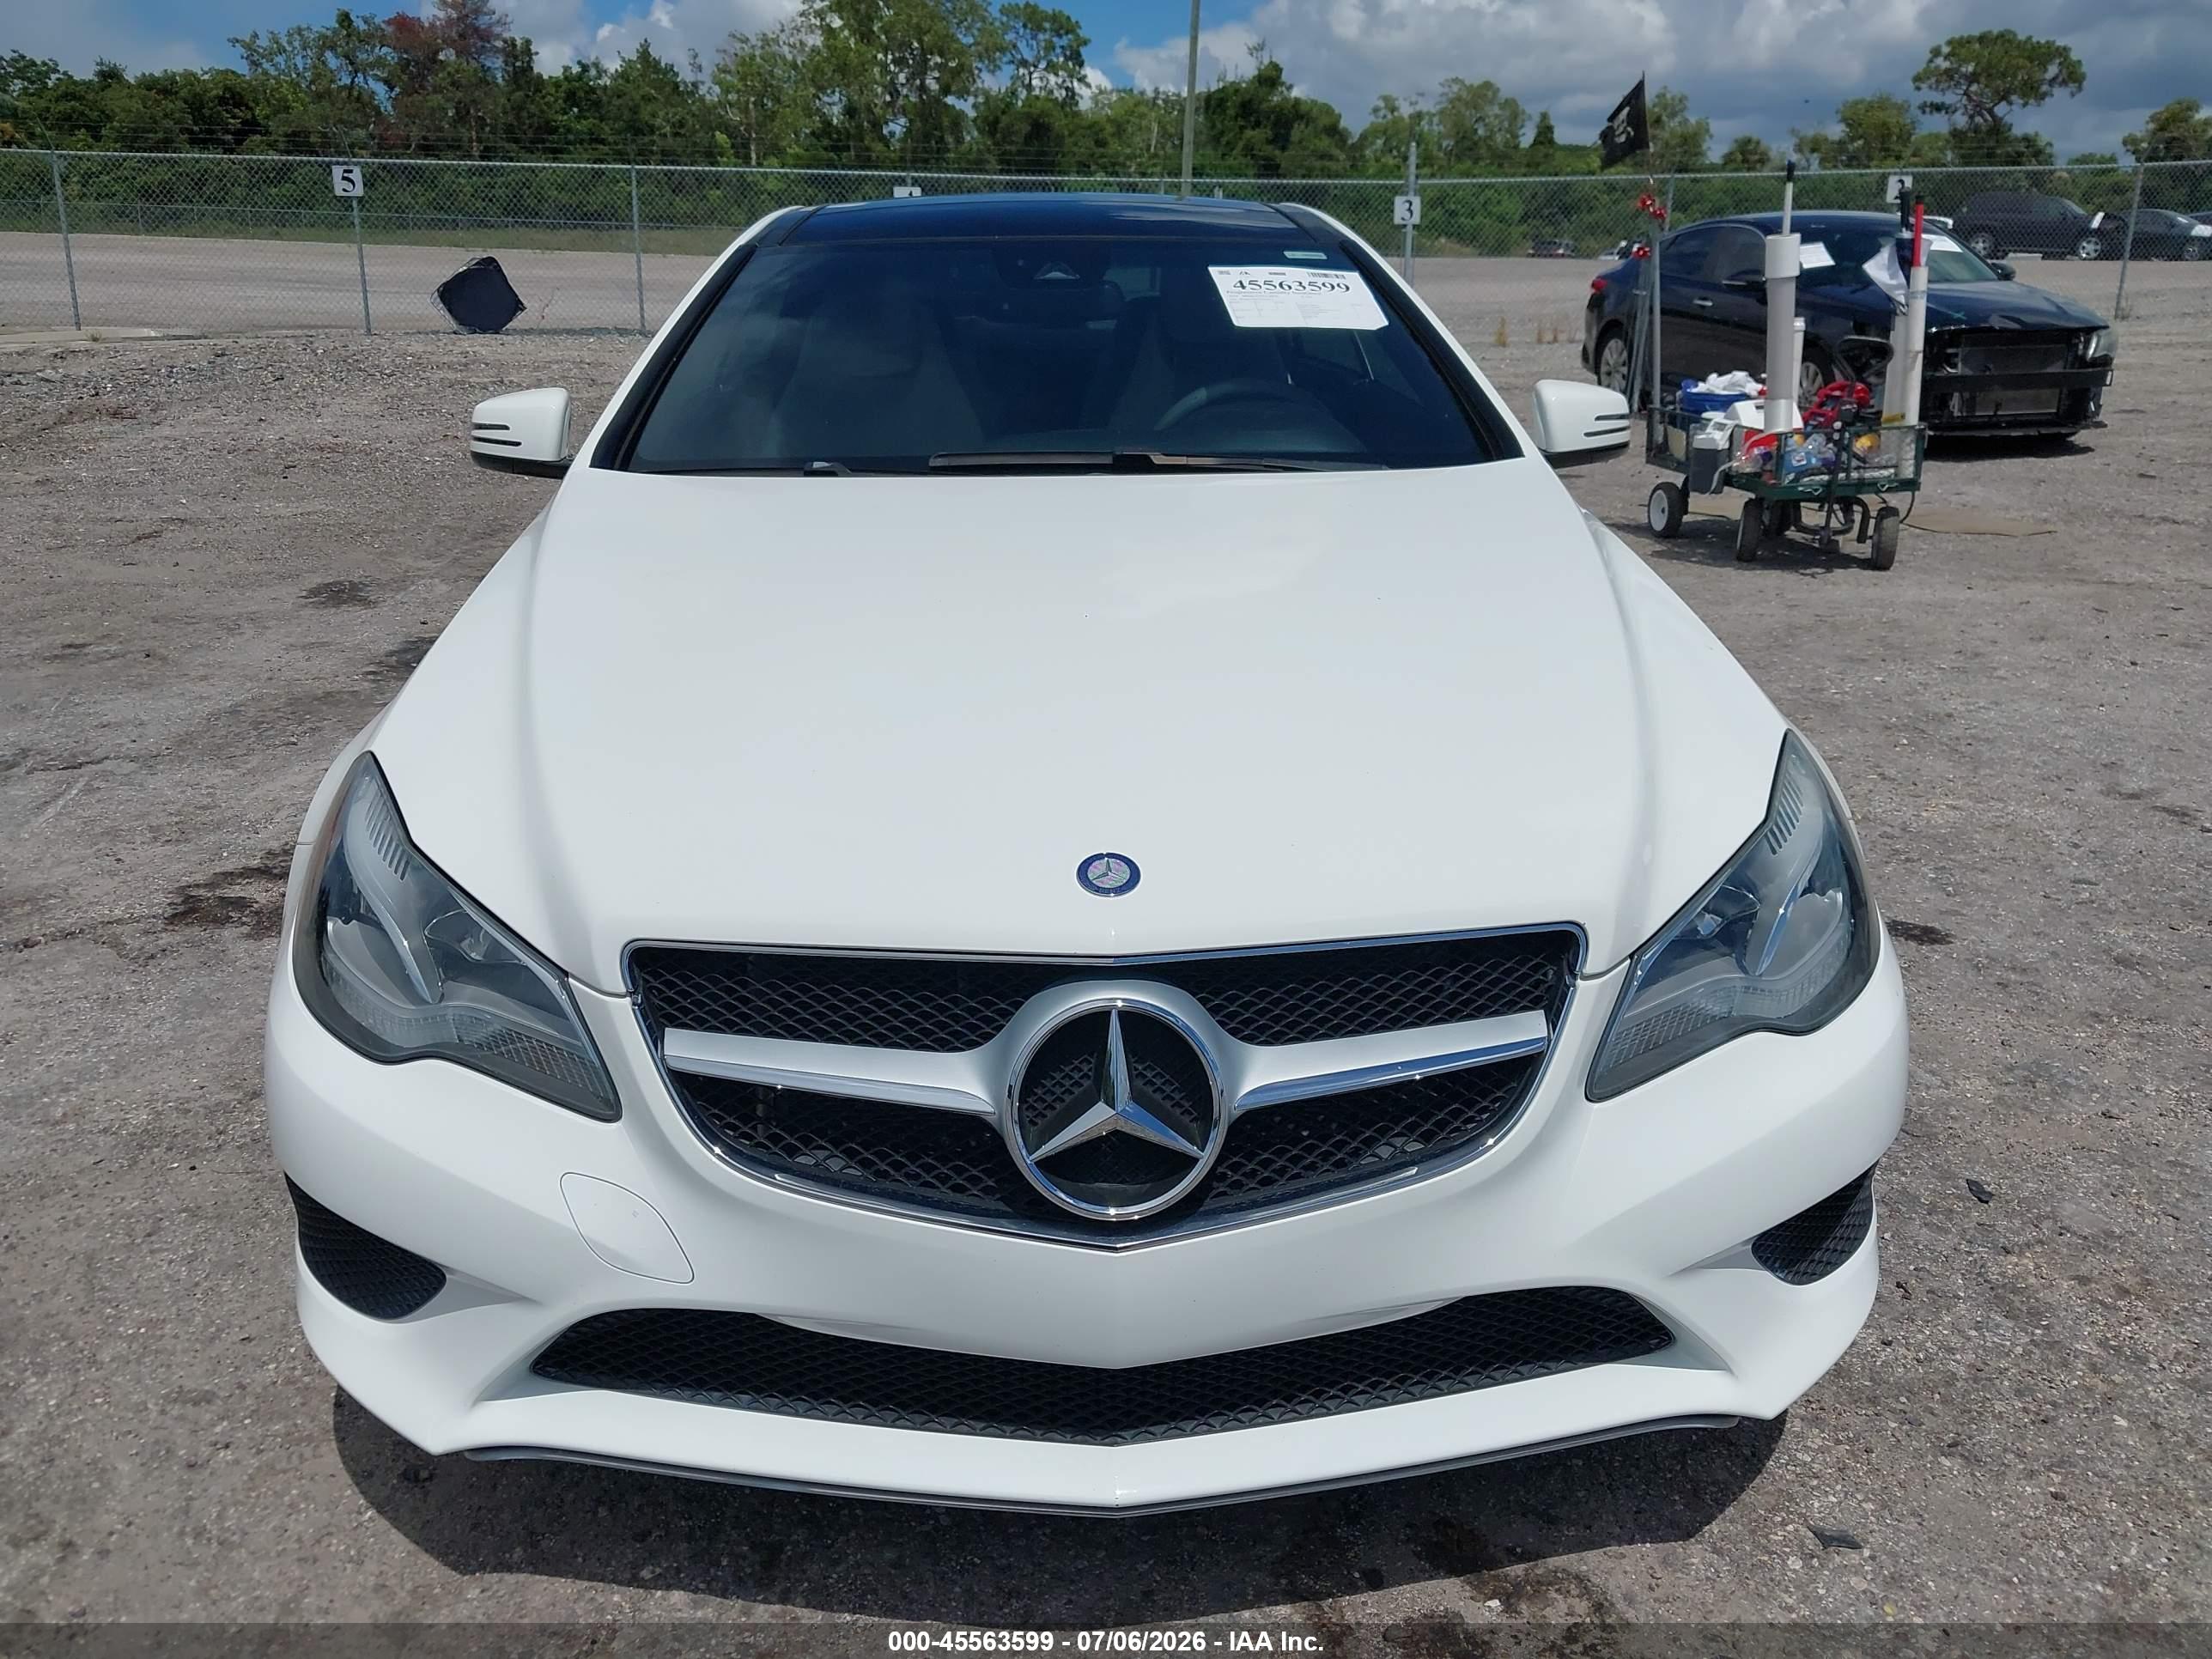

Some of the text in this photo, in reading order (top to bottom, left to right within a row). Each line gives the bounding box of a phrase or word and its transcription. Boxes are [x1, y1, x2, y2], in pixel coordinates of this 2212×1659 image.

[340, 168, 356, 193] 5
[1400, 198, 1414, 222] 3
[1232, 279, 1352, 294] 45563599
